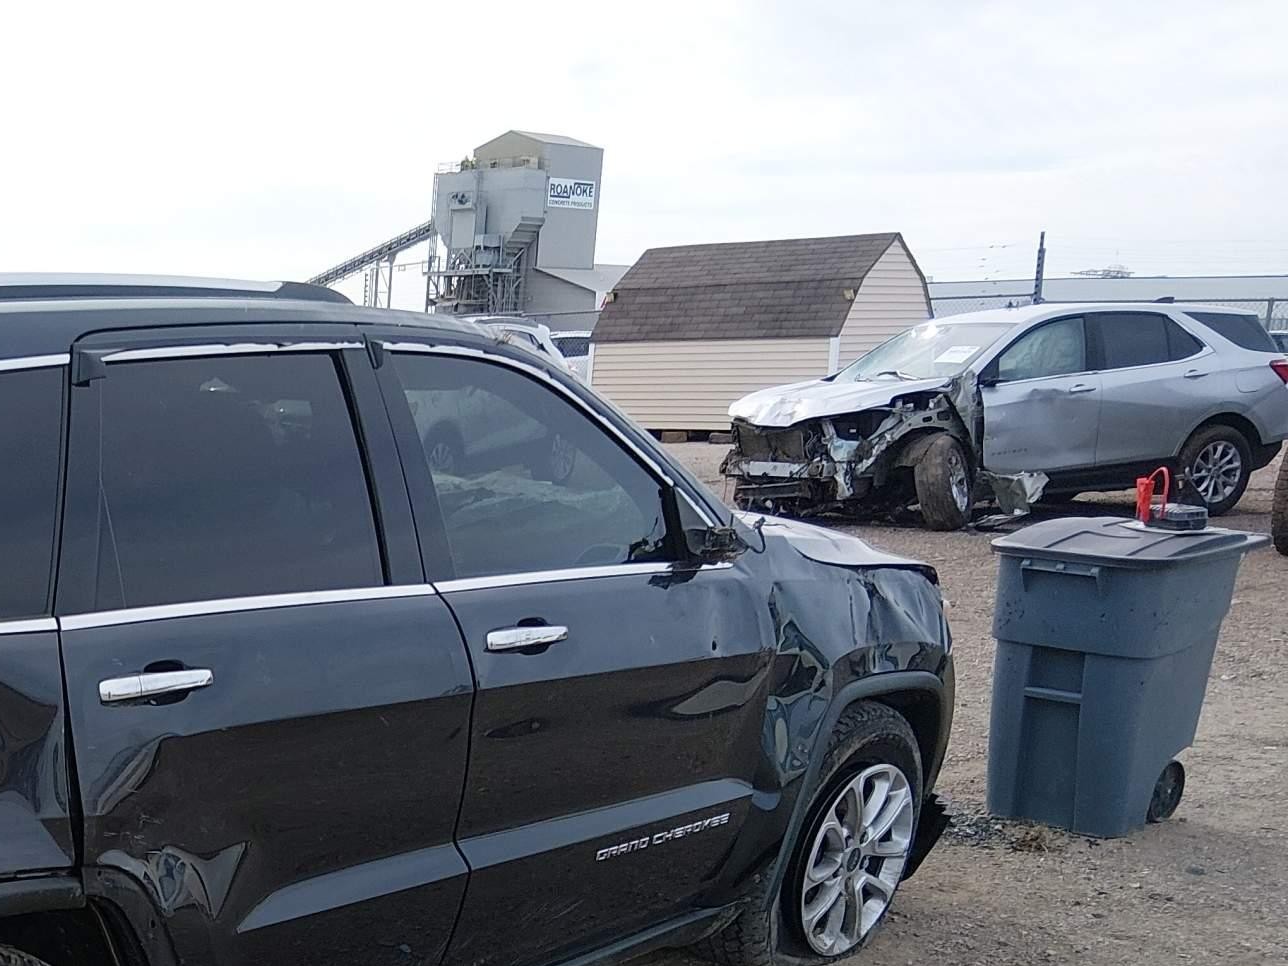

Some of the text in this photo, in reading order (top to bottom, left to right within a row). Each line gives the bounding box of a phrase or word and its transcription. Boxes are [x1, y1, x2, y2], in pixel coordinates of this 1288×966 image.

[550, 183, 593, 198] ROANOKE
[596, 812, 730, 861] GRAND CHEROKEE
